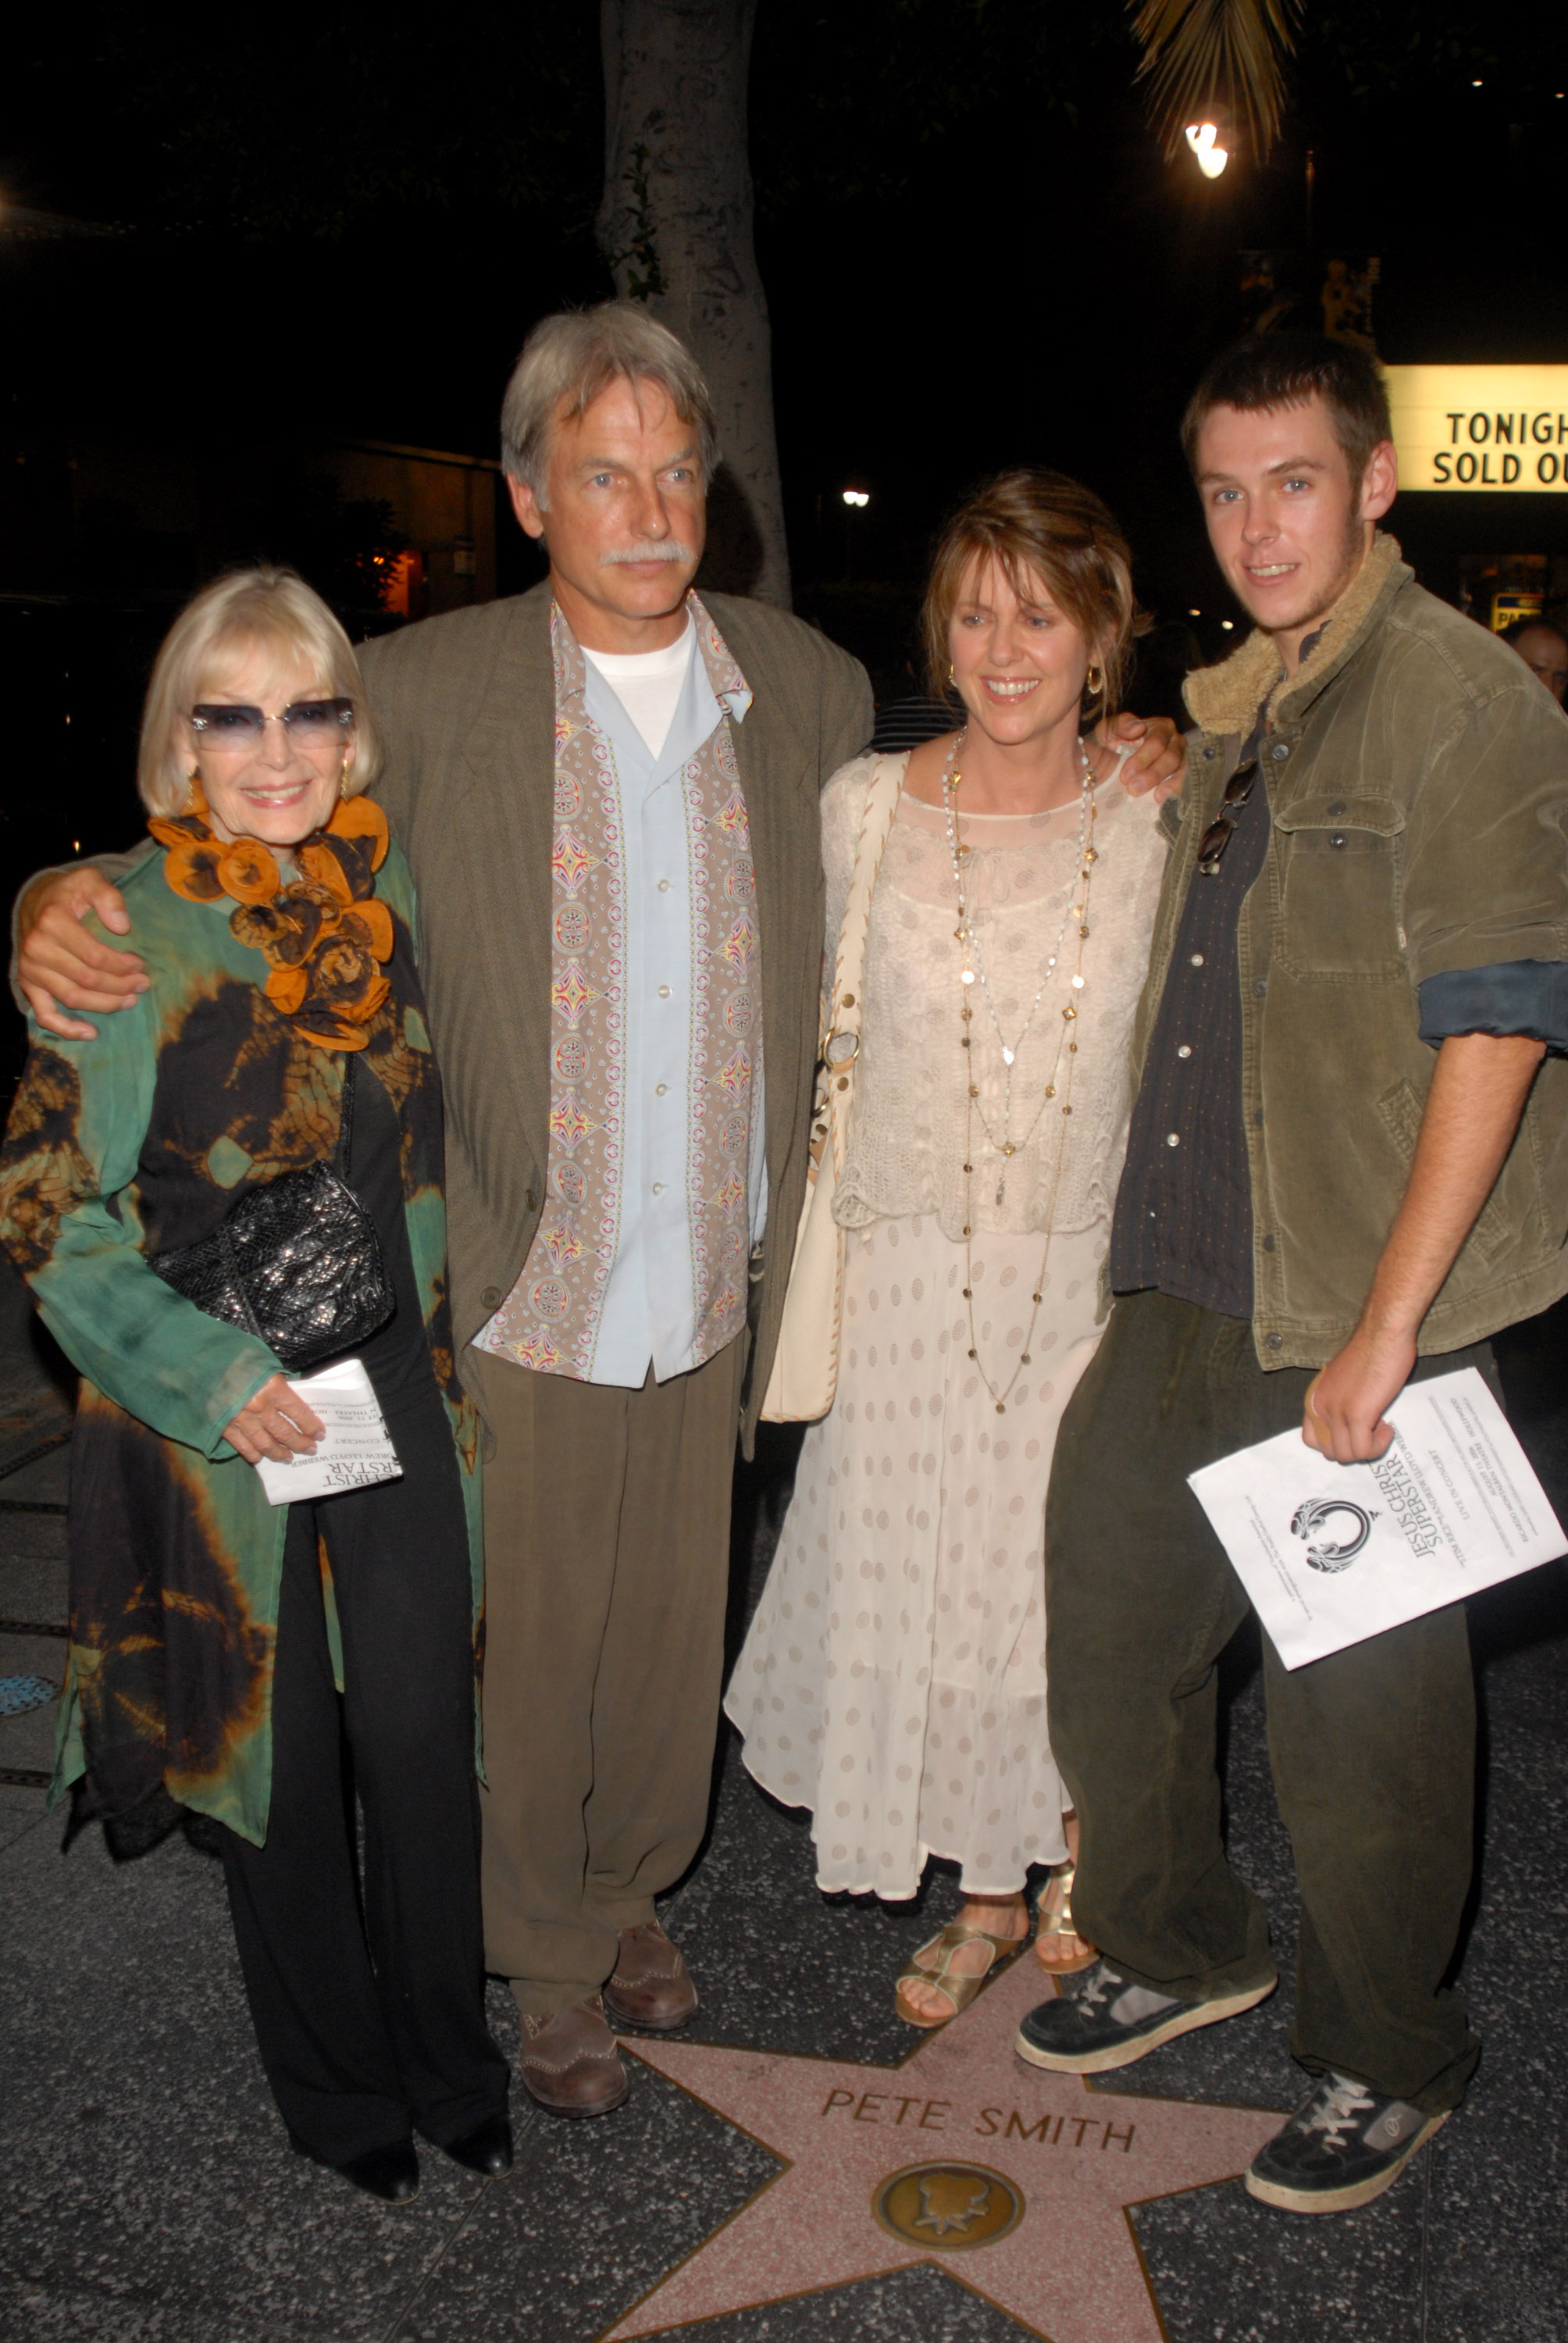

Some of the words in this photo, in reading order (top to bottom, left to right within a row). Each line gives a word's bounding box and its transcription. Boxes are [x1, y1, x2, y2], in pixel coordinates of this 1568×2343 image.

[1434, 451, 1522, 483] SOLD
[1538, 451, 1568, 483] O
[1450, 1398, 1476, 1438] HOLLYWOOD
[290, 1455, 328, 1467] WEBBER
[1403, 1451, 1424, 1479] LLOYD
[1428, 1450, 1453, 1488] CONCERT
[1474, 1442, 1492, 1470] THEATRE
[1418, 1479, 1442, 1516] ANDREW
[1449, 1488, 1459, 1499] IN
[1479, 1471, 1497, 1496] AUGUST
[1385, 1454, 1443, 1548] SUPERSTAR
[1455, 1500, 1470, 1521] LIVE
[1397, 1512, 1435, 1557] JESUS
[1441, 1525, 1456, 1543] RICE
[1510, 1512, 1529, 1542] RICARDO
[1451, 1543, 1463, 1561] TIM
[821, 2088, 952, 2131] PETE
[975, 2108, 1135, 2153] SMITH
